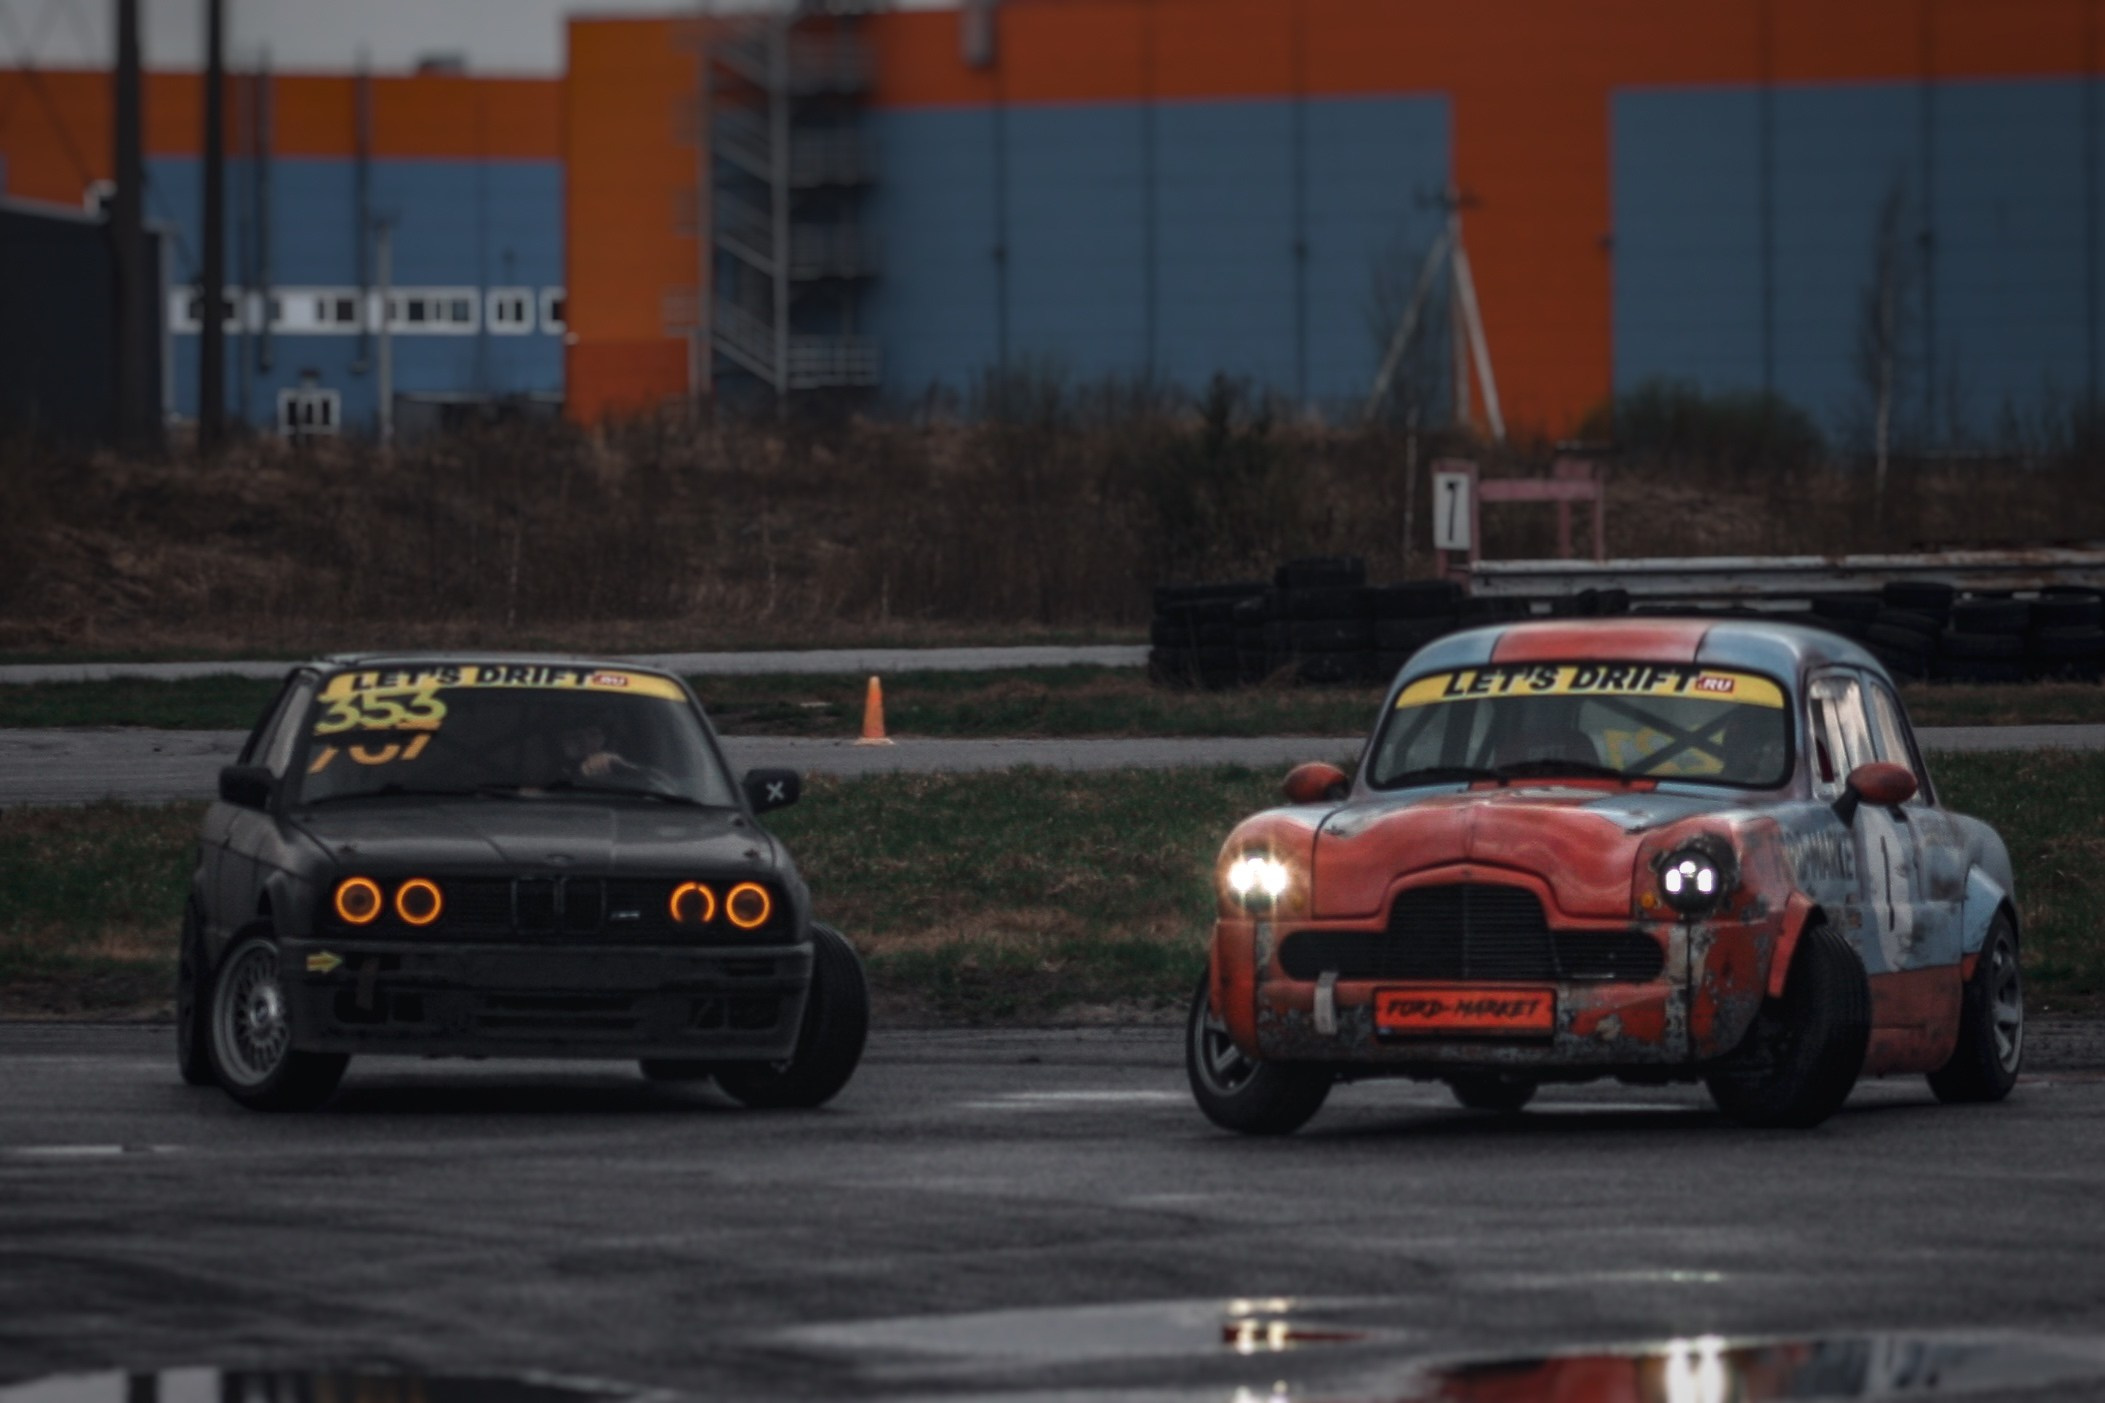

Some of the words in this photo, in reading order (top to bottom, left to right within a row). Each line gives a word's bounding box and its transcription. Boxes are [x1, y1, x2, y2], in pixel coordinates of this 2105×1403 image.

[351, 664, 459, 690] LET'S
[474, 664, 596, 687] DRIFT
[1442, 666, 1559, 697] LET'S
[1569, 666, 1700, 693] DRIFT
[313, 685, 447, 735] 353
[1386, 998, 1540, 1018] FORD-MARKET
